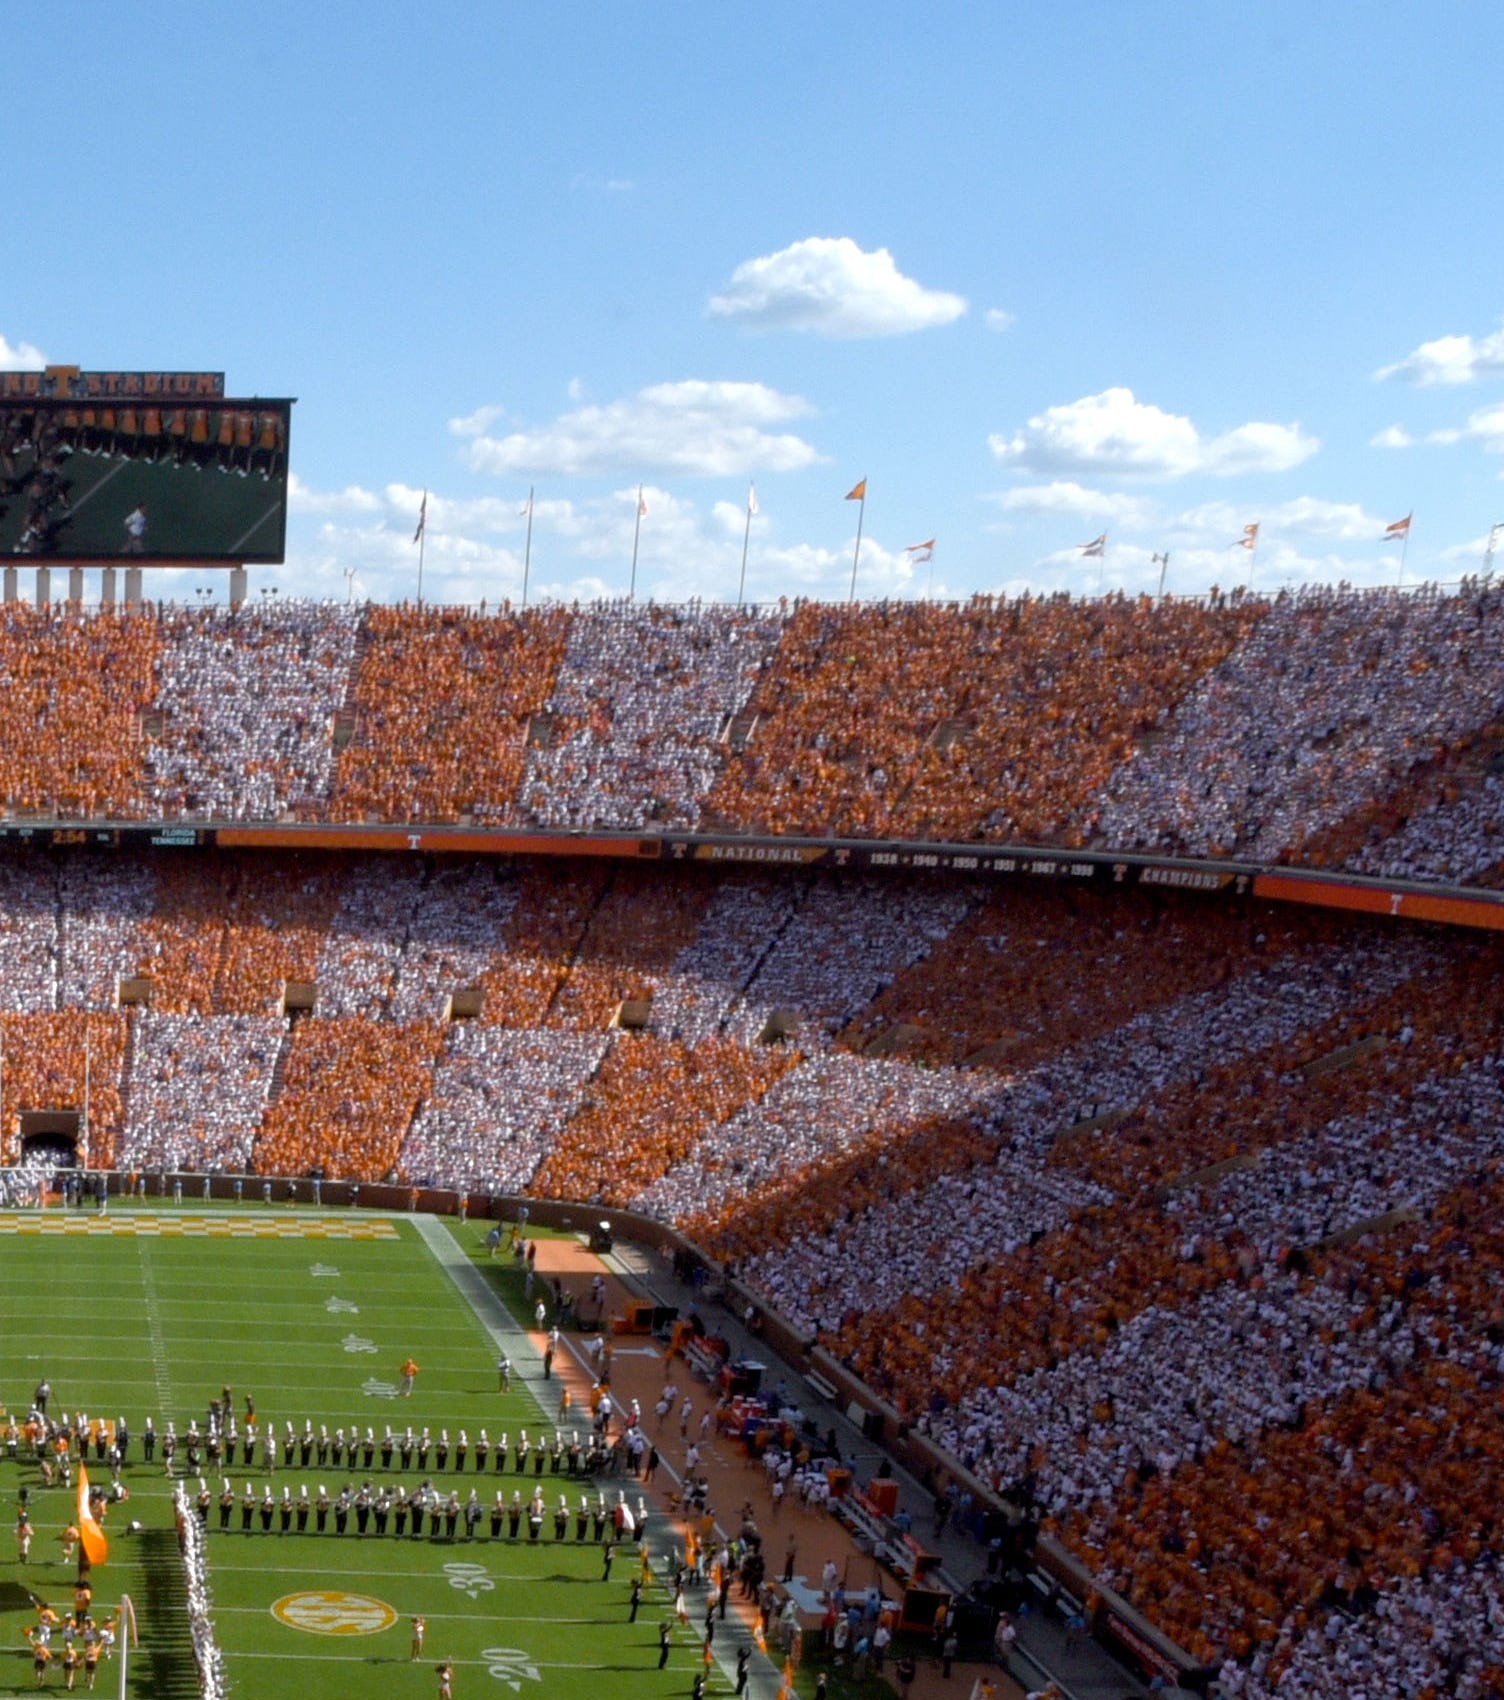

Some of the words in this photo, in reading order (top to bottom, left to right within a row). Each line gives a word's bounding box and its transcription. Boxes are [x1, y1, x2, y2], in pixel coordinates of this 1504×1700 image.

[45, 365, 80, 397] T
[87, 373, 216, 393] STADIUM
[711, 846, 803, 862] NATIONAL
[1143, 867, 1219, 889] CHAMPIONS
[442, 1562, 496, 1591] 30
[480, 1647, 542, 1683] 20
